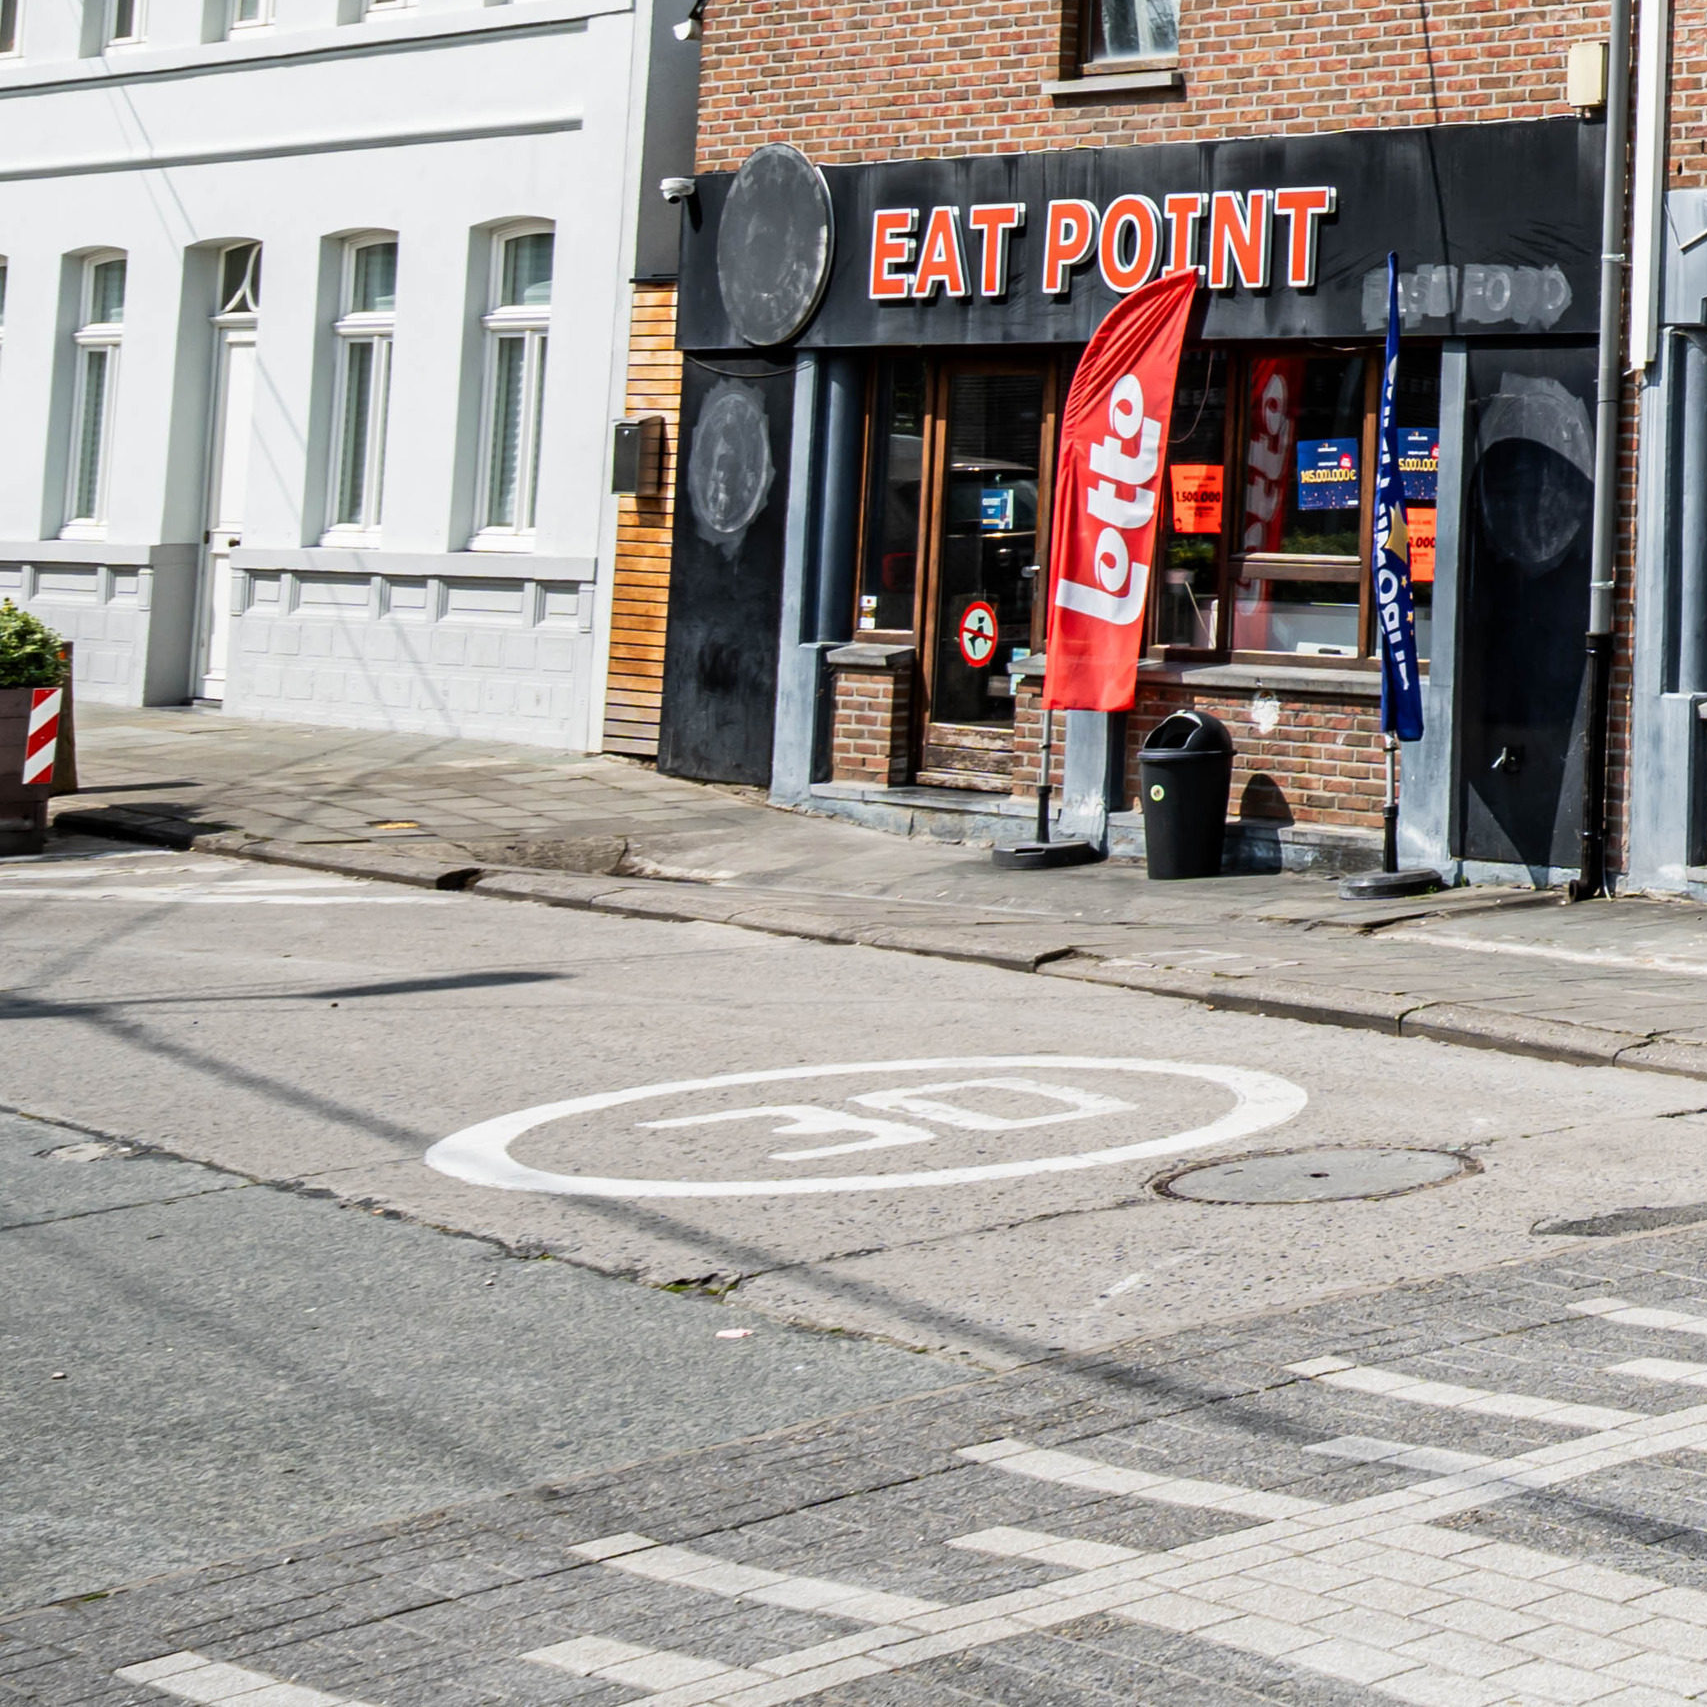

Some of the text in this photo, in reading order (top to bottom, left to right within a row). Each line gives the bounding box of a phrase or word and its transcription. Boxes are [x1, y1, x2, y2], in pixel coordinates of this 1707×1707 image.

[869, 187, 1337, 299] EAT POINT
[1055, 373, 1162, 625] Lotto
[634, 1077, 1141, 1161] 30
